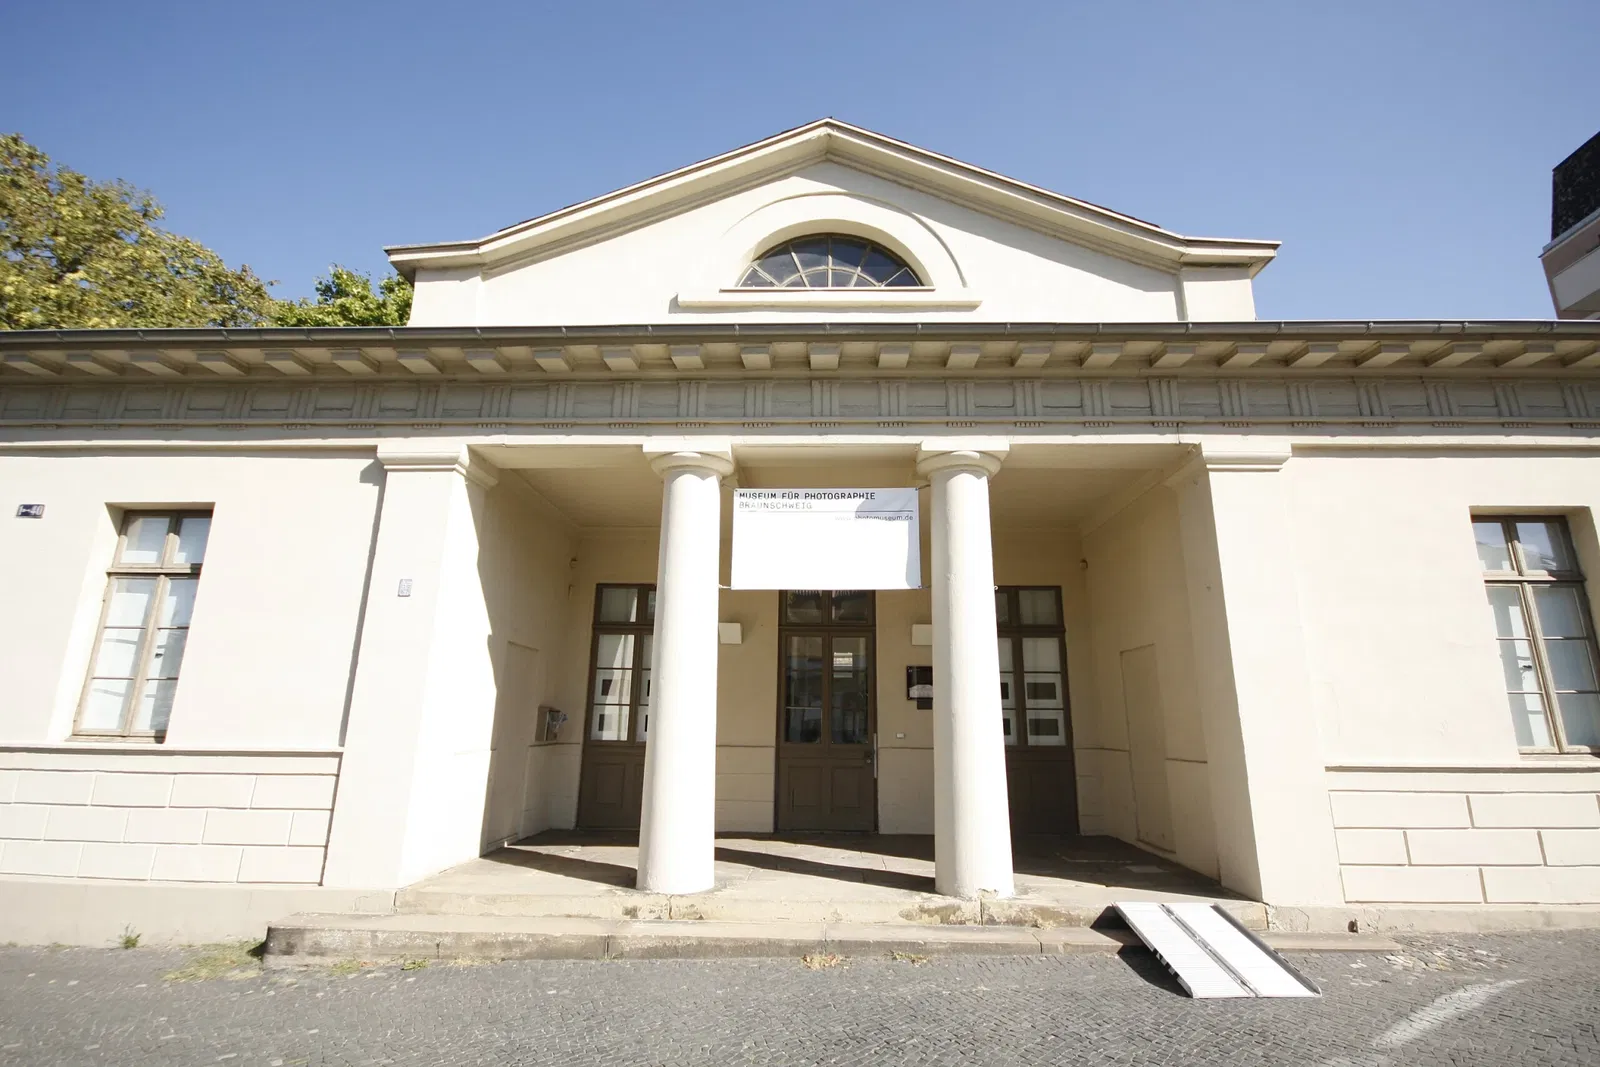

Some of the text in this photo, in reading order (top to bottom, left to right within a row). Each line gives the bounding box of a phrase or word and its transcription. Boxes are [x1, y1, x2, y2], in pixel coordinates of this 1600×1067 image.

[739, 491, 876, 500] MUSEUM FÜR PHOTOGRAPHIE
[739, 502, 813, 510] BRAUNSCHWEIG
